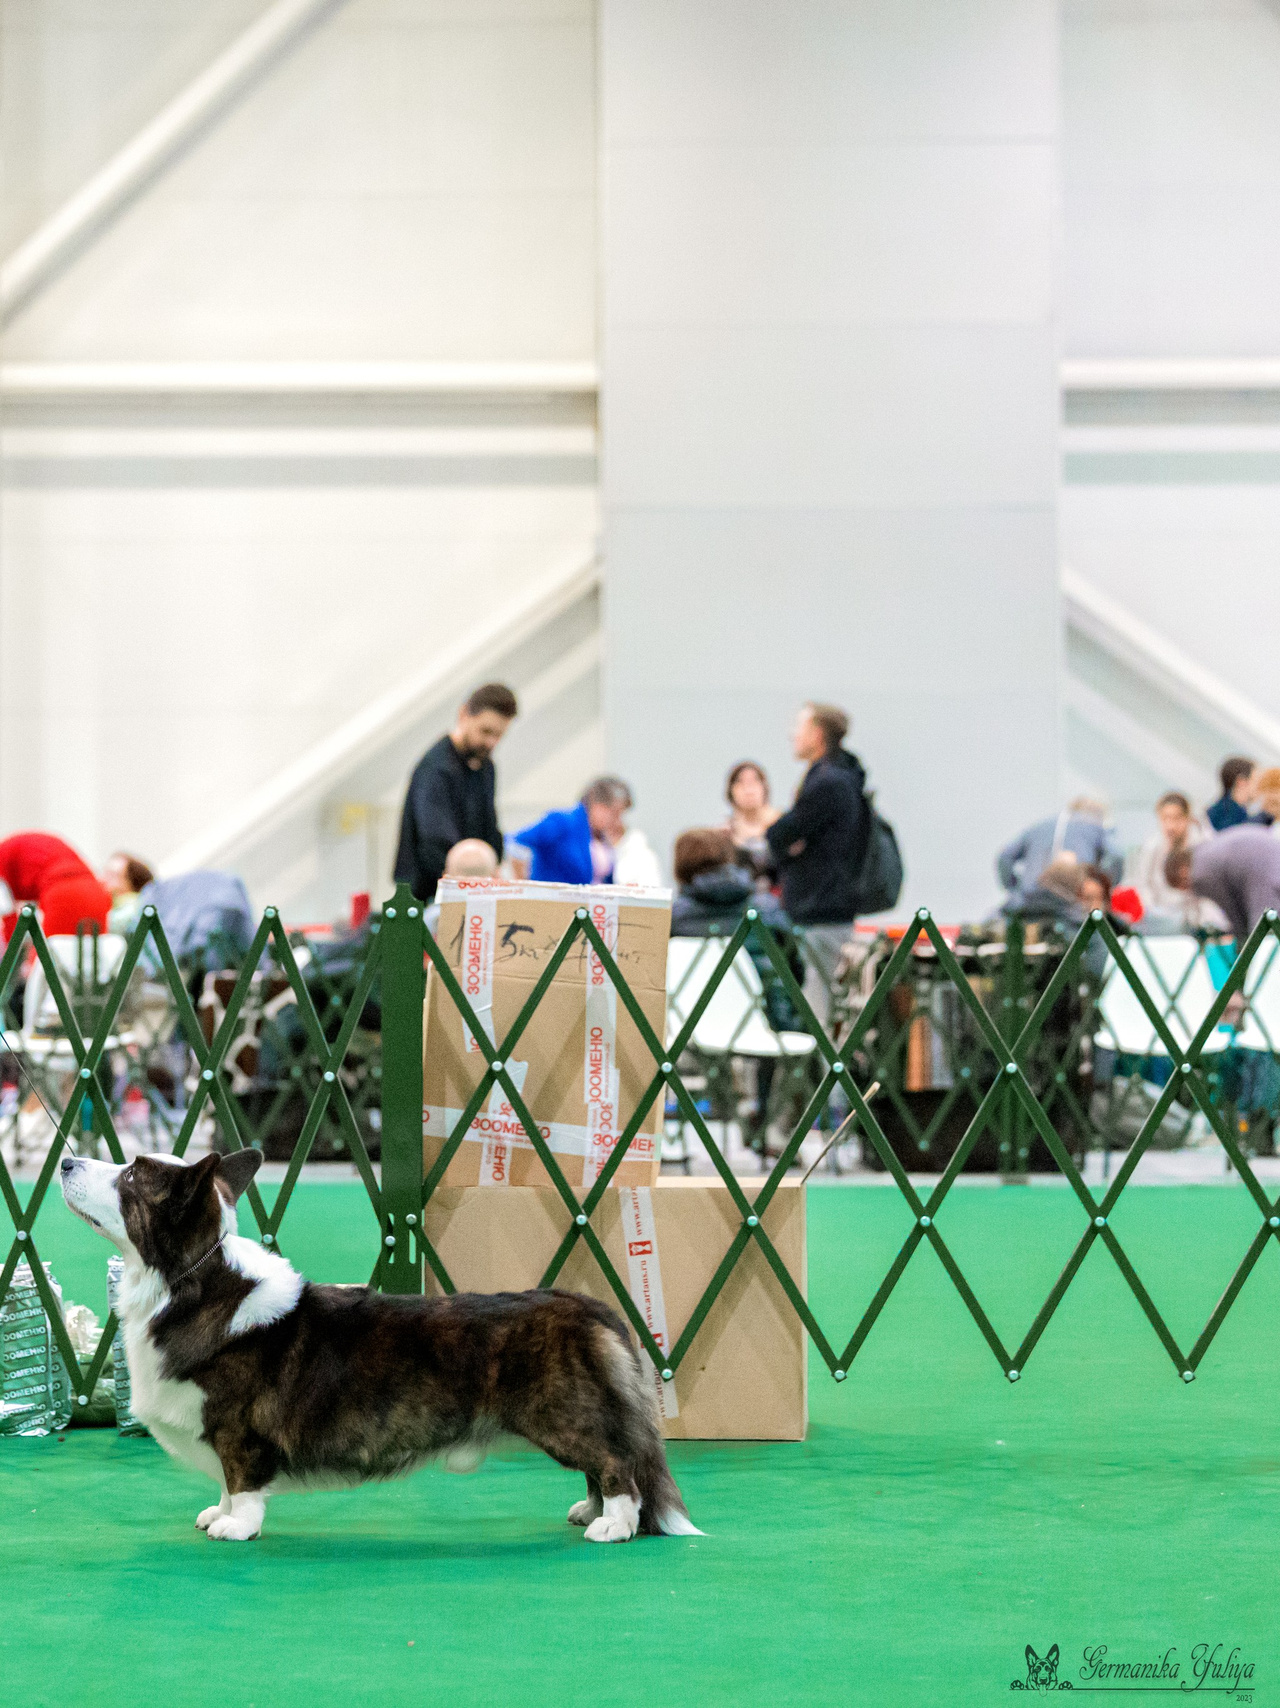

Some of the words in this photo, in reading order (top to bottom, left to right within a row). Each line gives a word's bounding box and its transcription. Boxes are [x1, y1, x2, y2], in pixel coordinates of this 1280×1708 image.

[467, 915, 483, 995] ЗООМЕНЮ
[591, 904, 606, 986] ЗООНЮ
[470, 1116, 551, 1139] ЗООМЕЮ
[640, 1259, 654, 1329] www.artans.ru
